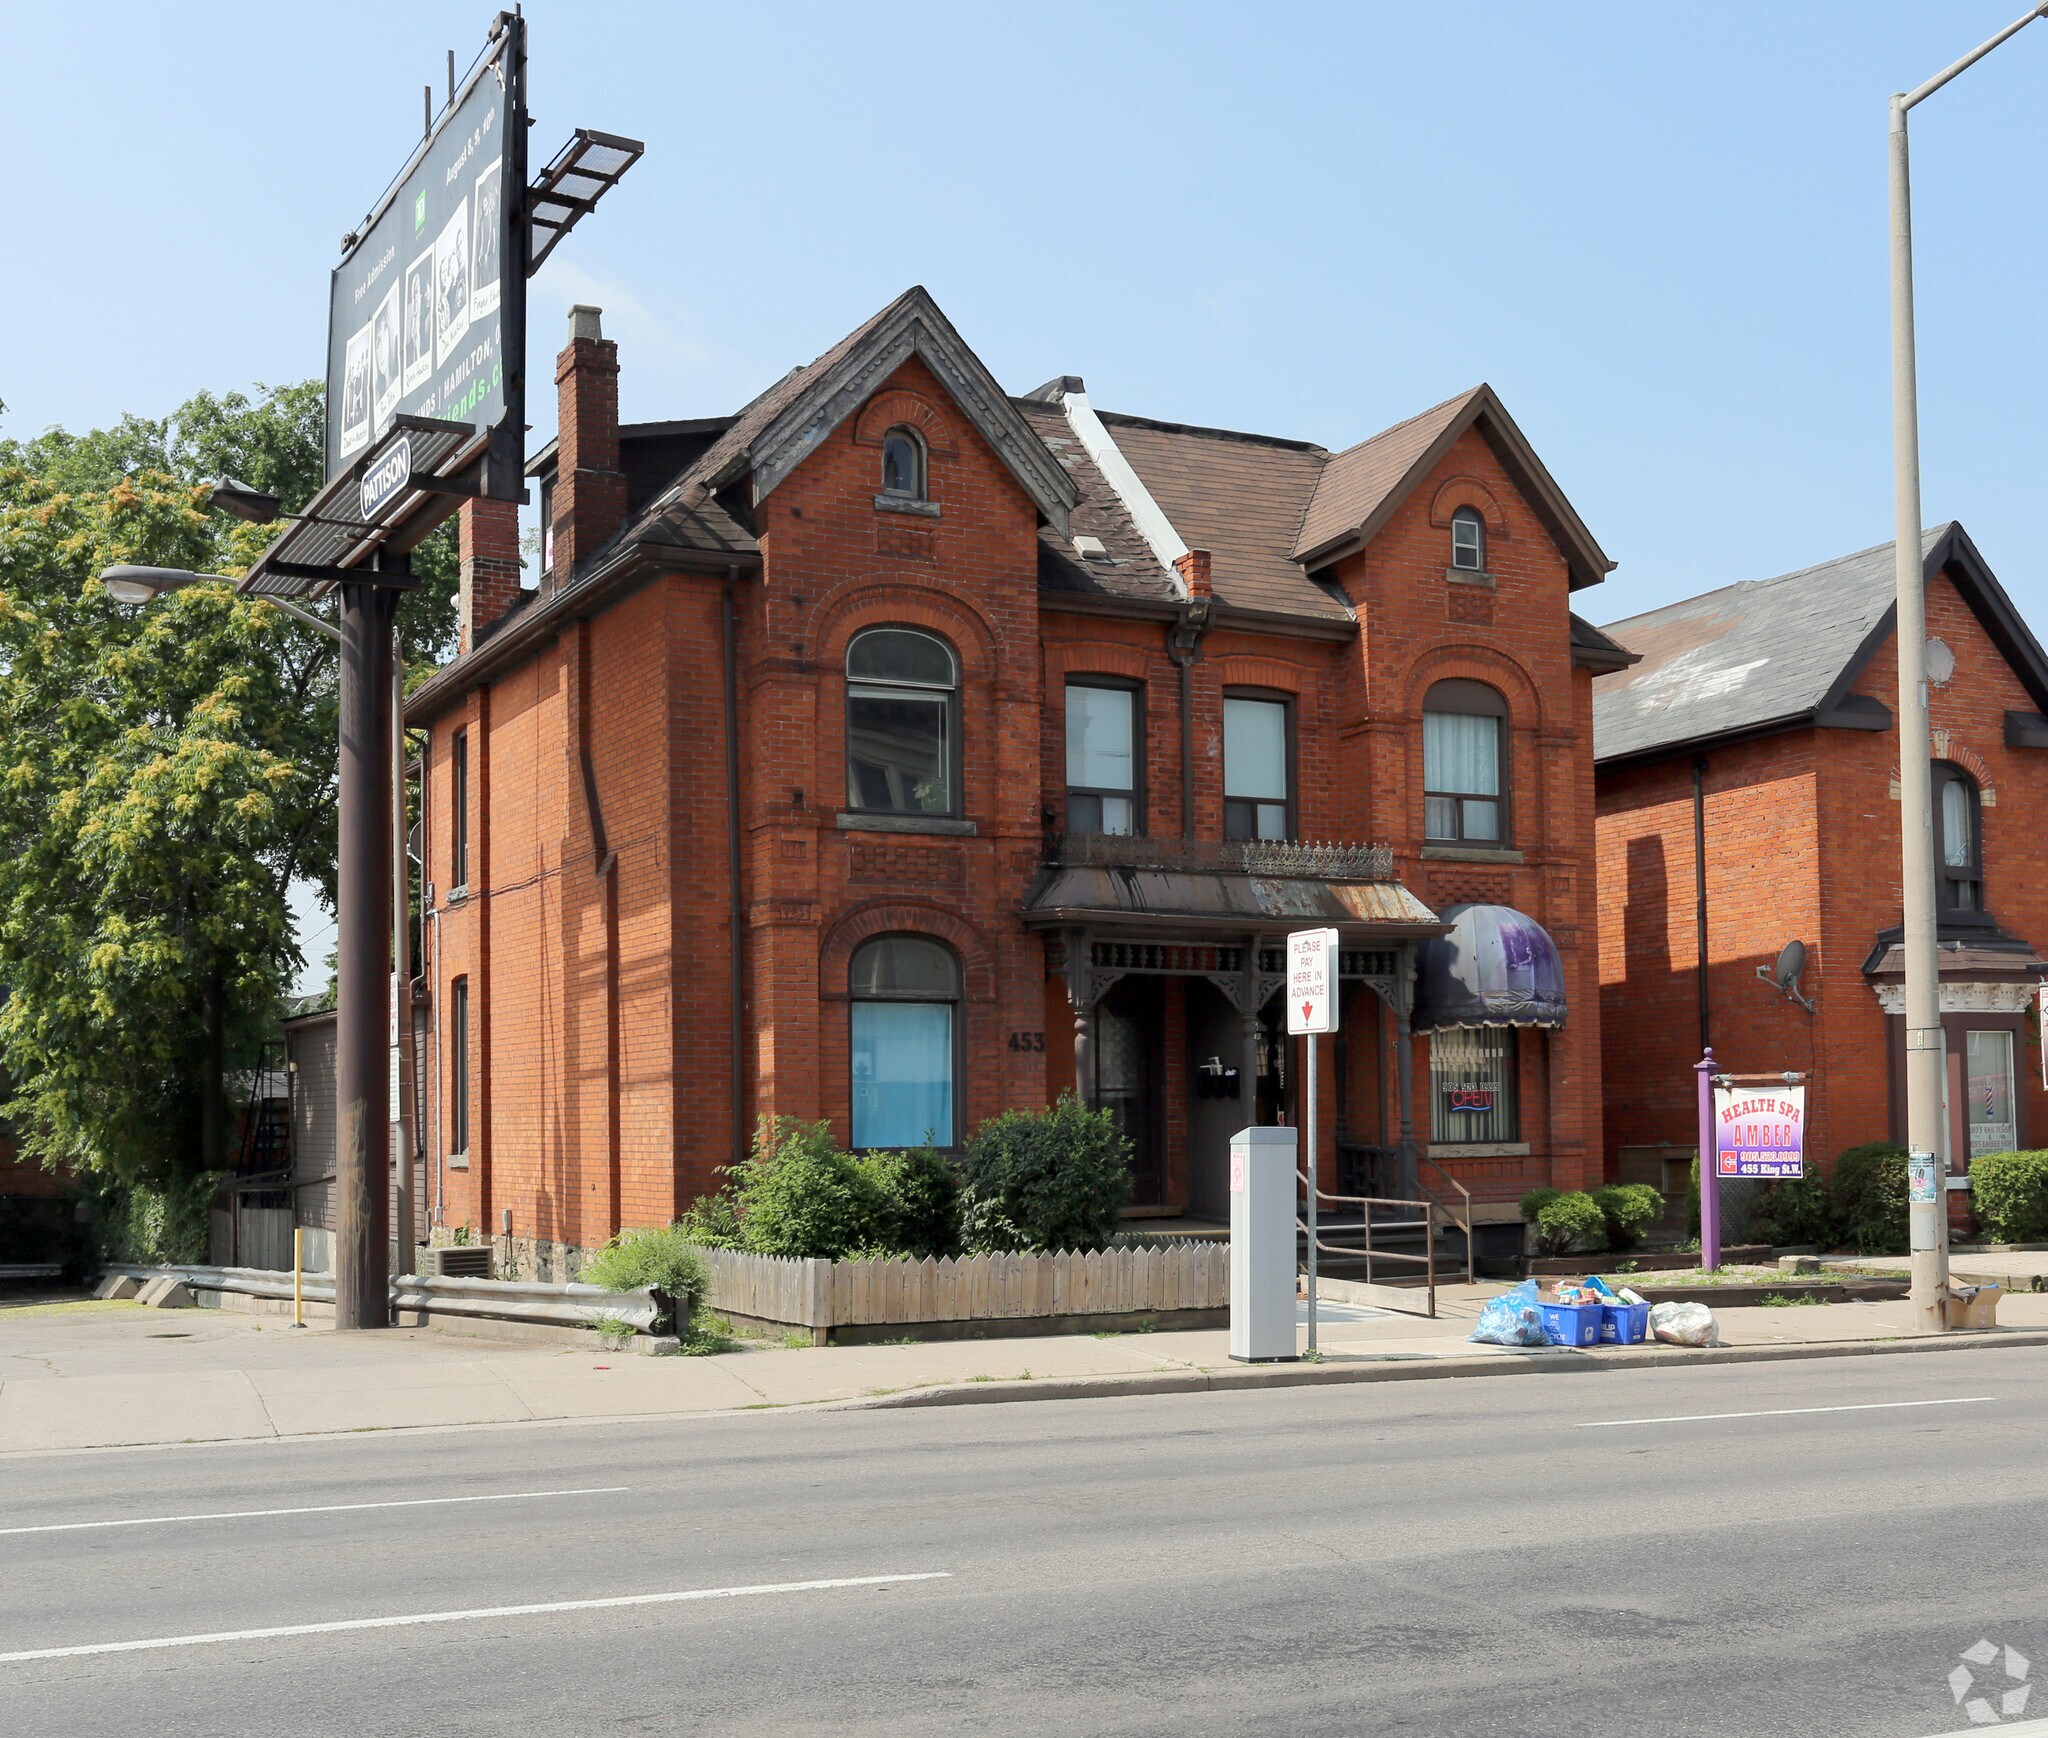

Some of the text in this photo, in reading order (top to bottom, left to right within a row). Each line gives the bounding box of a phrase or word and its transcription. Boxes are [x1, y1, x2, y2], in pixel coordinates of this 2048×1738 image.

[445, 145, 467, 187] August
[354, 245, 395, 305] Free Admission
[444, 336, 493, 400] HAMILTON,
[363, 448, 406, 510] PATTISON
[1293, 940, 1321, 954] PLEASE
[1301, 956, 1313, 968] PAY
[1293, 970, 1322, 983] HERE IN
[1291, 984, 1324, 998] ADVANCE
[1008, 1031, 1045, 1052] 453
[1452, 1090, 1492, 1106] OPEN
[1721, 1098, 1801, 1124] HEALTH SPA
[1733, 1124, 1791, 1146] AMBER
[1982, 1140, 2001, 1148] BARBER
[1740, 1163, 1759, 1174] 455
[1760, 1163, 1780, 1176] King
[1549, 1313, 1560, 1321] WE
